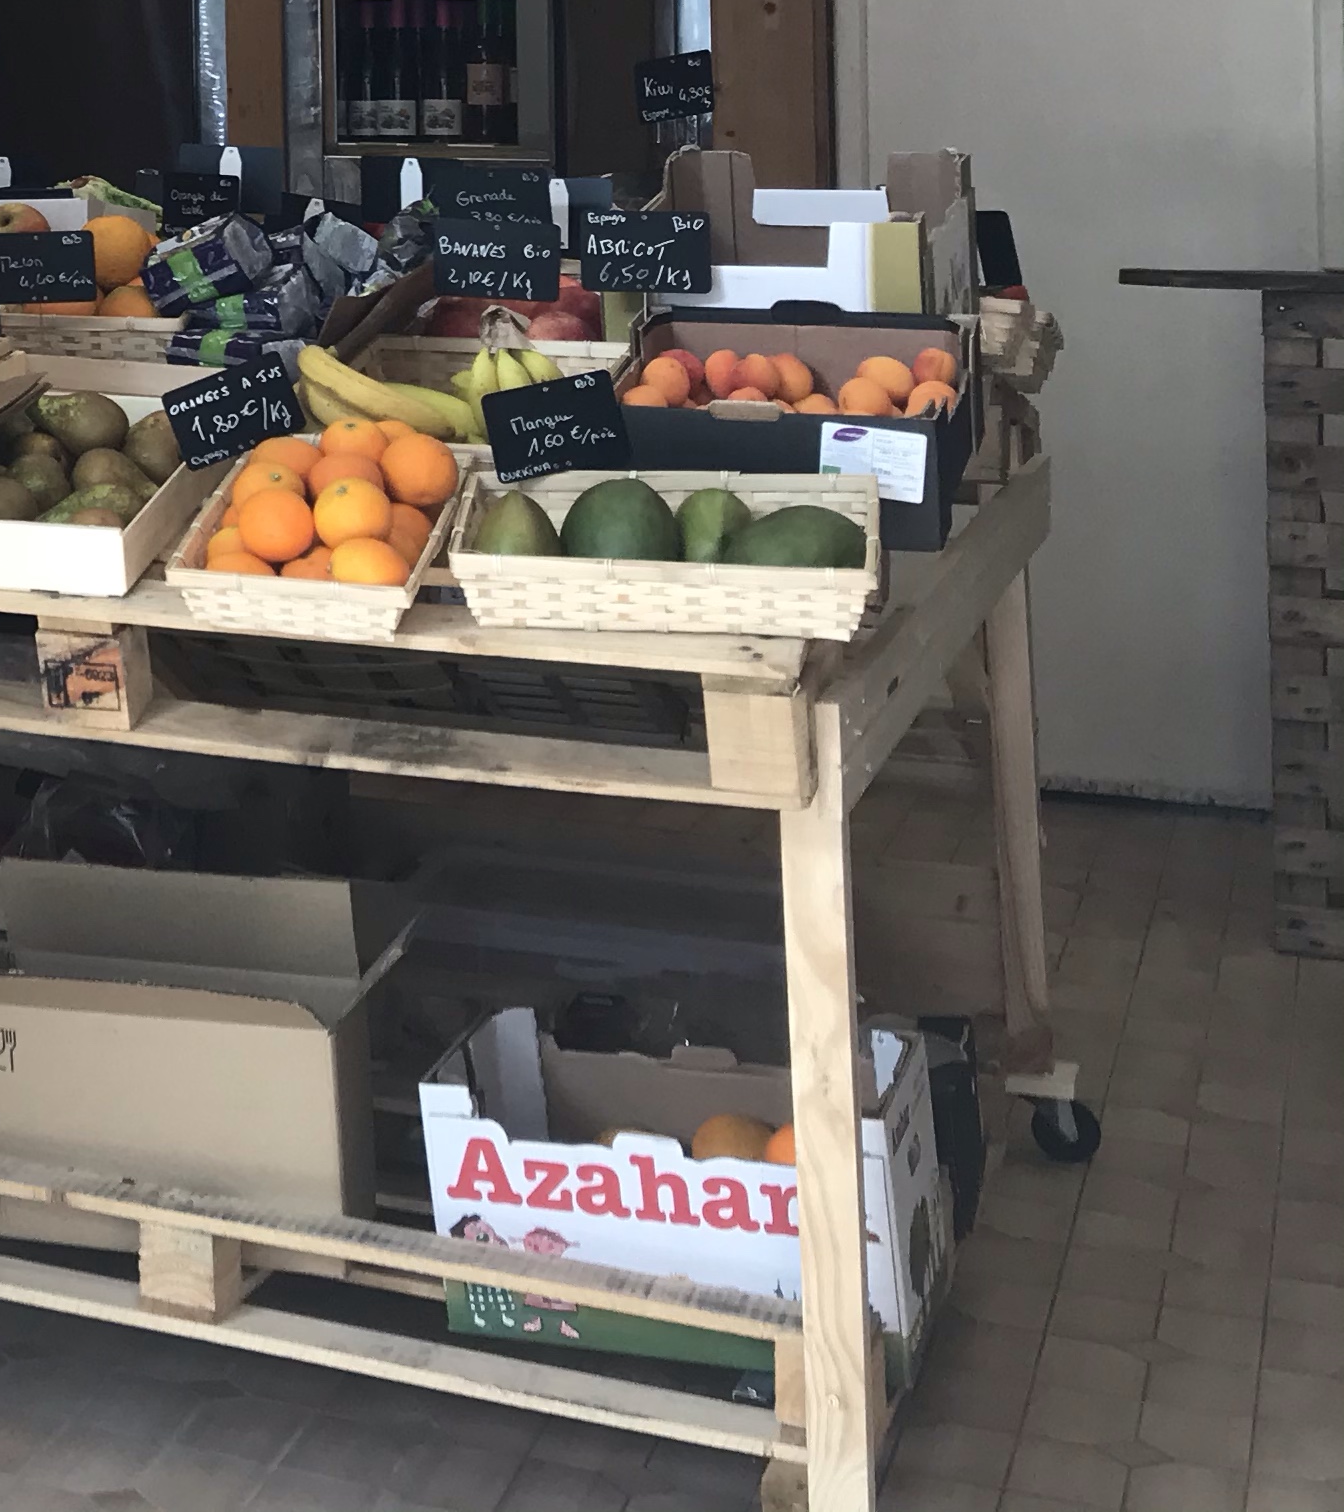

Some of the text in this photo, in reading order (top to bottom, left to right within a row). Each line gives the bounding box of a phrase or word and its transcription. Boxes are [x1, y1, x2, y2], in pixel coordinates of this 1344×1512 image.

[643, 76, 674, 98] Kiwi
[455, 188, 517, 207] Grenade
[671, 214, 705, 232] Bio
[438, 234, 552, 260] BANANES Bio
[586, 233, 675, 261] ABRICOT
[0, 255, 45, 274] Melon
[168, 383, 232, 417] ORANGES
[255, 366, 283, 385] JUS
[509, 413, 575, 436] Mangue
[526, 432, 565, 458] 1,60
